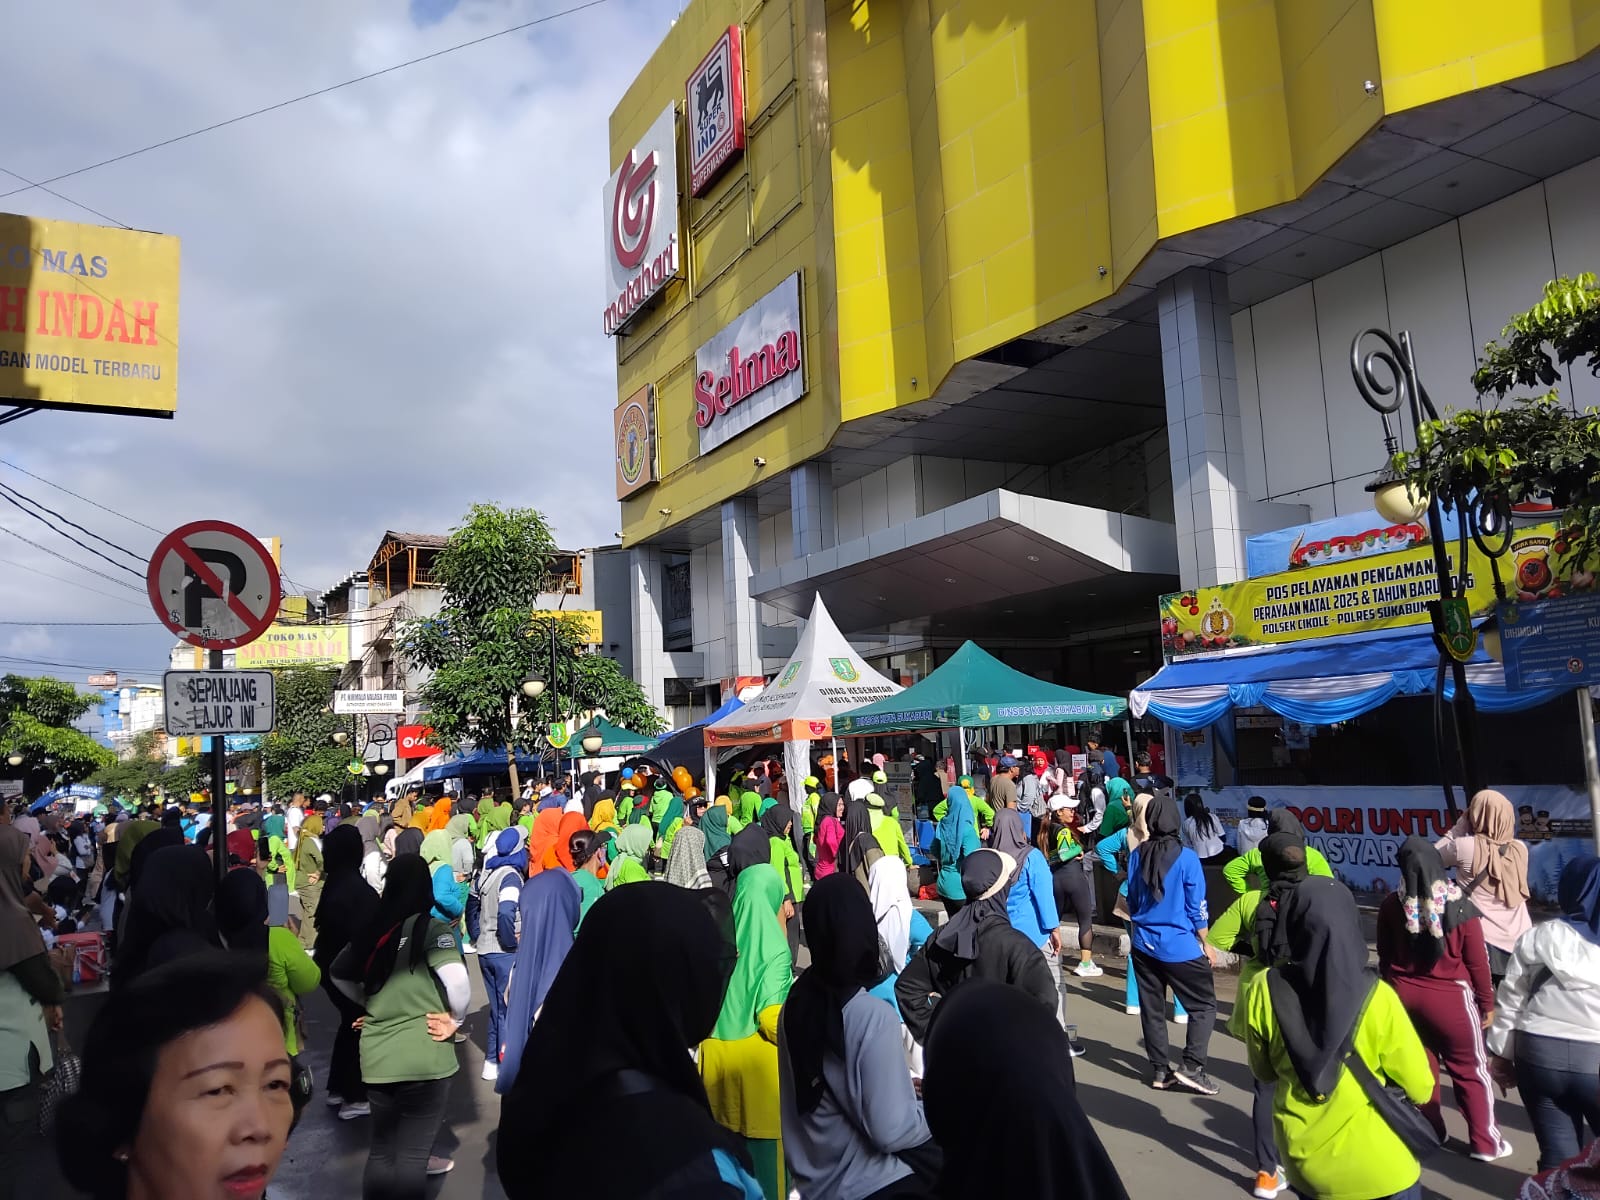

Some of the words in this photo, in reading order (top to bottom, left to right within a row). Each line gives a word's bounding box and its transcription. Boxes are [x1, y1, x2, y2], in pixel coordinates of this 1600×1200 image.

[699, 103, 722, 135] SUPER
[692, 136, 735, 191] SUPERMARKET
[0, 243, 31, 269] O
[41, 248, 108, 278] MAS
[603, 232, 678, 335] matahari
[36, 290, 159, 345] INDAH
[35, 353, 88, 374] MODEL
[93, 359, 161, 381] TERBARU
[695, 330, 800, 429] Selma
[1253, 602, 1301, 621] PERAYAAN
[1302, 596, 1331, 615] NATAL
[1333, 592, 1359, 610] 2025
[1361, 589, 1371, 604] &
[1371, 583, 1407, 603] TAHUN
[1409, 579, 1440, 599] BARU
[1266, 584, 1289, 602] POS
[1291, 573, 1359, 598] PELAYANAN
[1262, 618, 1296, 635] POLSEK
[1298, 615, 1329, 630] CIKOLE
[1337, 609, 1376, 625] POLRES
[1377, 600, 1438, 619] SUKABUM
[267, 633, 295, 641] TOKO
[297, 632, 318, 641] MAS
[187, 677, 257, 703] SEPANJANG
[819, 687, 847, 696] DINAS
[847, 686, 894, 695] KESEHATAN
[828, 695, 851, 703] KOTA
[193, 705, 233, 729] LAJUR
[240, 705, 255, 728] INI
[998, 707, 1030, 718] DINSOS
[1031, 706, 1053, 716] KOTA
[1054, 704, 1097, 715] SUKABUMI
[1369, 808, 1464, 838] UNTU
